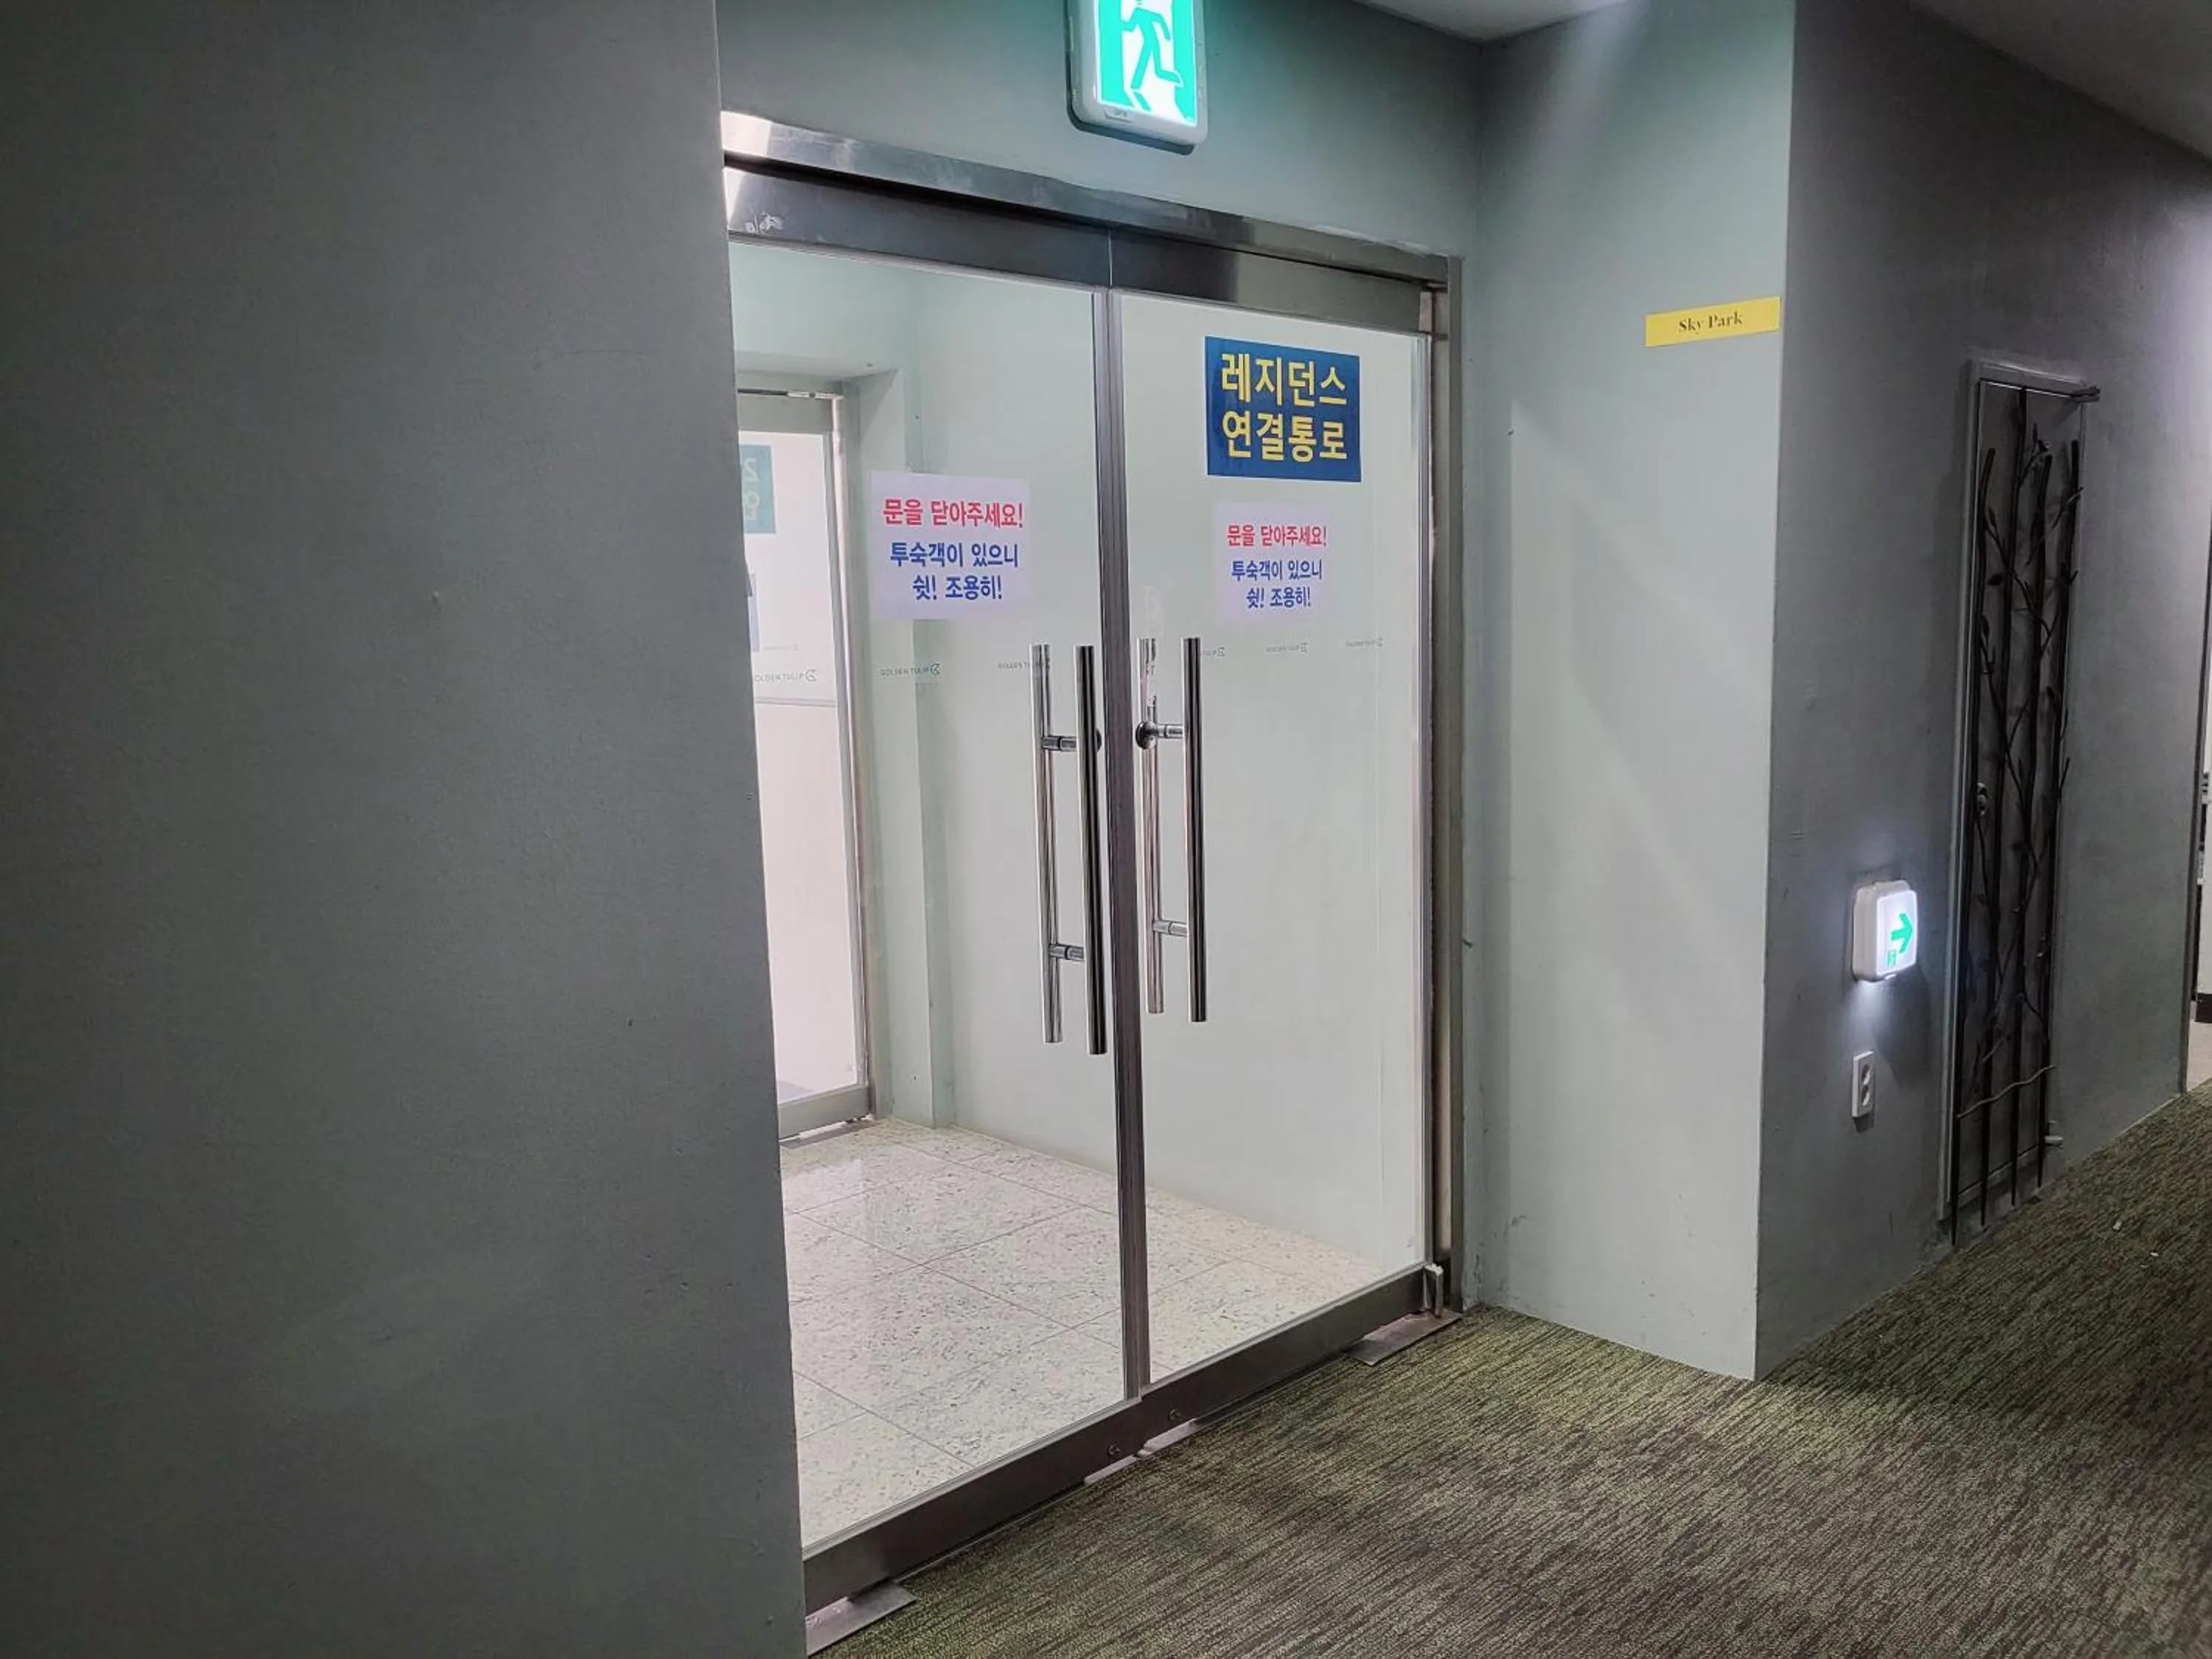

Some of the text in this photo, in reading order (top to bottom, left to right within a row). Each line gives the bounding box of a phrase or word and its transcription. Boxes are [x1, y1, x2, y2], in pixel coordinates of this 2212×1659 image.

[1677, 311, 1743, 335] Sky Park
[1220, 352, 1348, 408] 레지던스
[1221, 410, 1348, 463] 연결통로
[883, 498, 1023, 529] 문을 닫아주세요!
[1227, 524, 1327, 547] 문을 닫아주세요!
[890, 542, 1019, 568] 투숙객이 있으니
[1231, 559, 1323, 582] 투숙객이 있으니
[912, 574, 1003, 601] 쉿! 조용히!
[1246, 586, 1311, 609] 쉿! 조용히!
